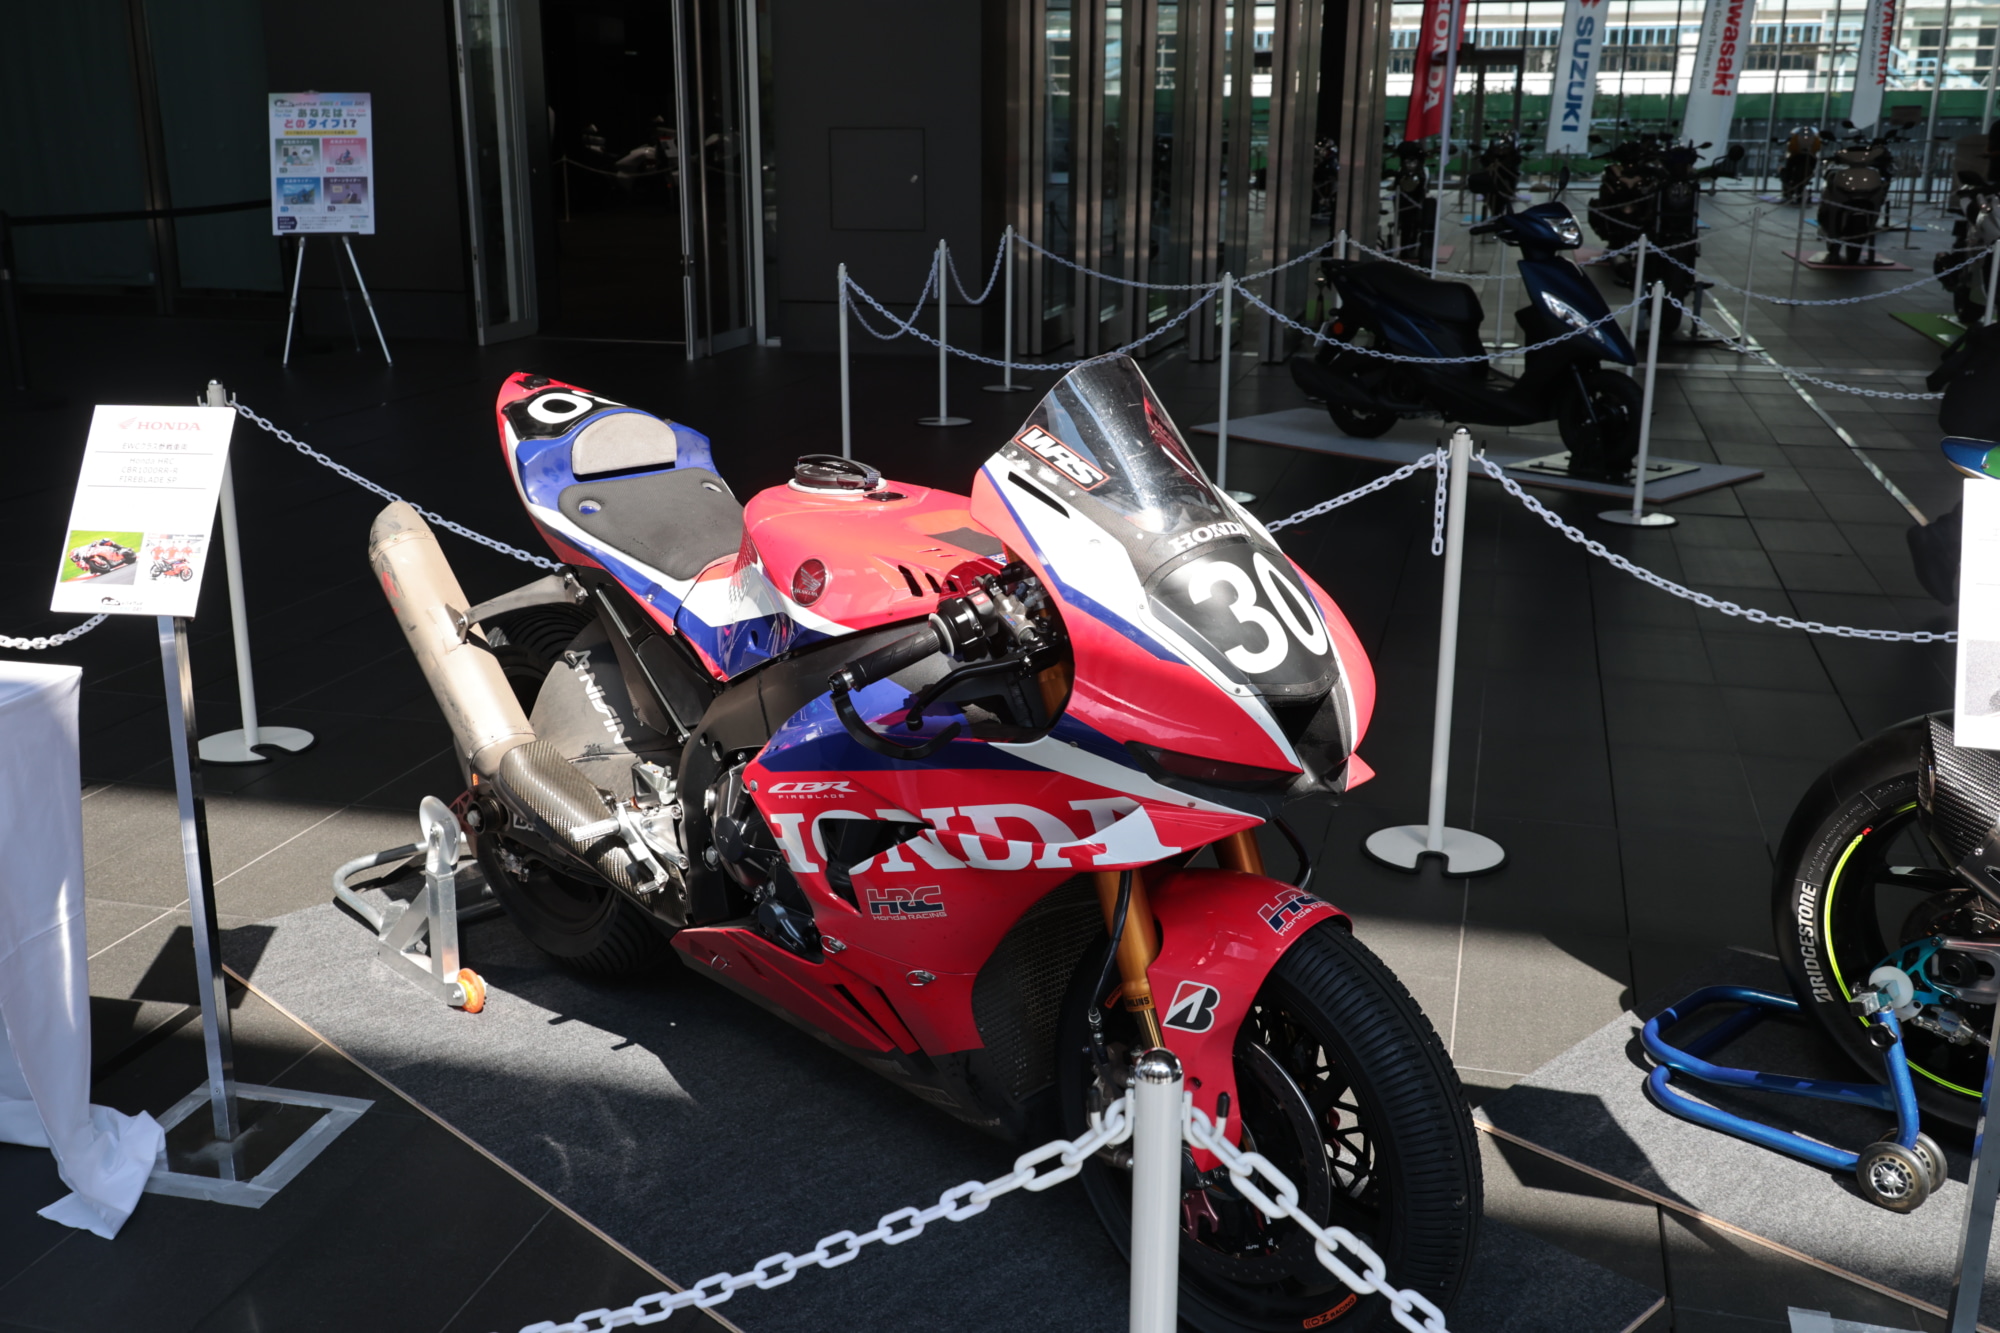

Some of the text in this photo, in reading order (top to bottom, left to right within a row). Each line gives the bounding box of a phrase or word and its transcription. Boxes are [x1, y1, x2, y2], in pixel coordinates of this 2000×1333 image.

[1712, 0, 1744, 96] wasaki
[1561, 15, 1595, 132] SUZUKI
[298, 108, 343, 118] あなたは
[137, 421, 201, 431] HONDA
[1020, 428, 1104, 484] WRS
[1188, 552, 1328, 674] 30
[768, 781, 858, 793] CBR
[866, 885, 944, 915] HRC
[908, 912, 947, 920] RACING
[1278, 907, 1313, 937] Honda
[1797, 882, 1835, 1003] BRIDGESTONE
[1330, 1297, 1355, 1319] RACING
